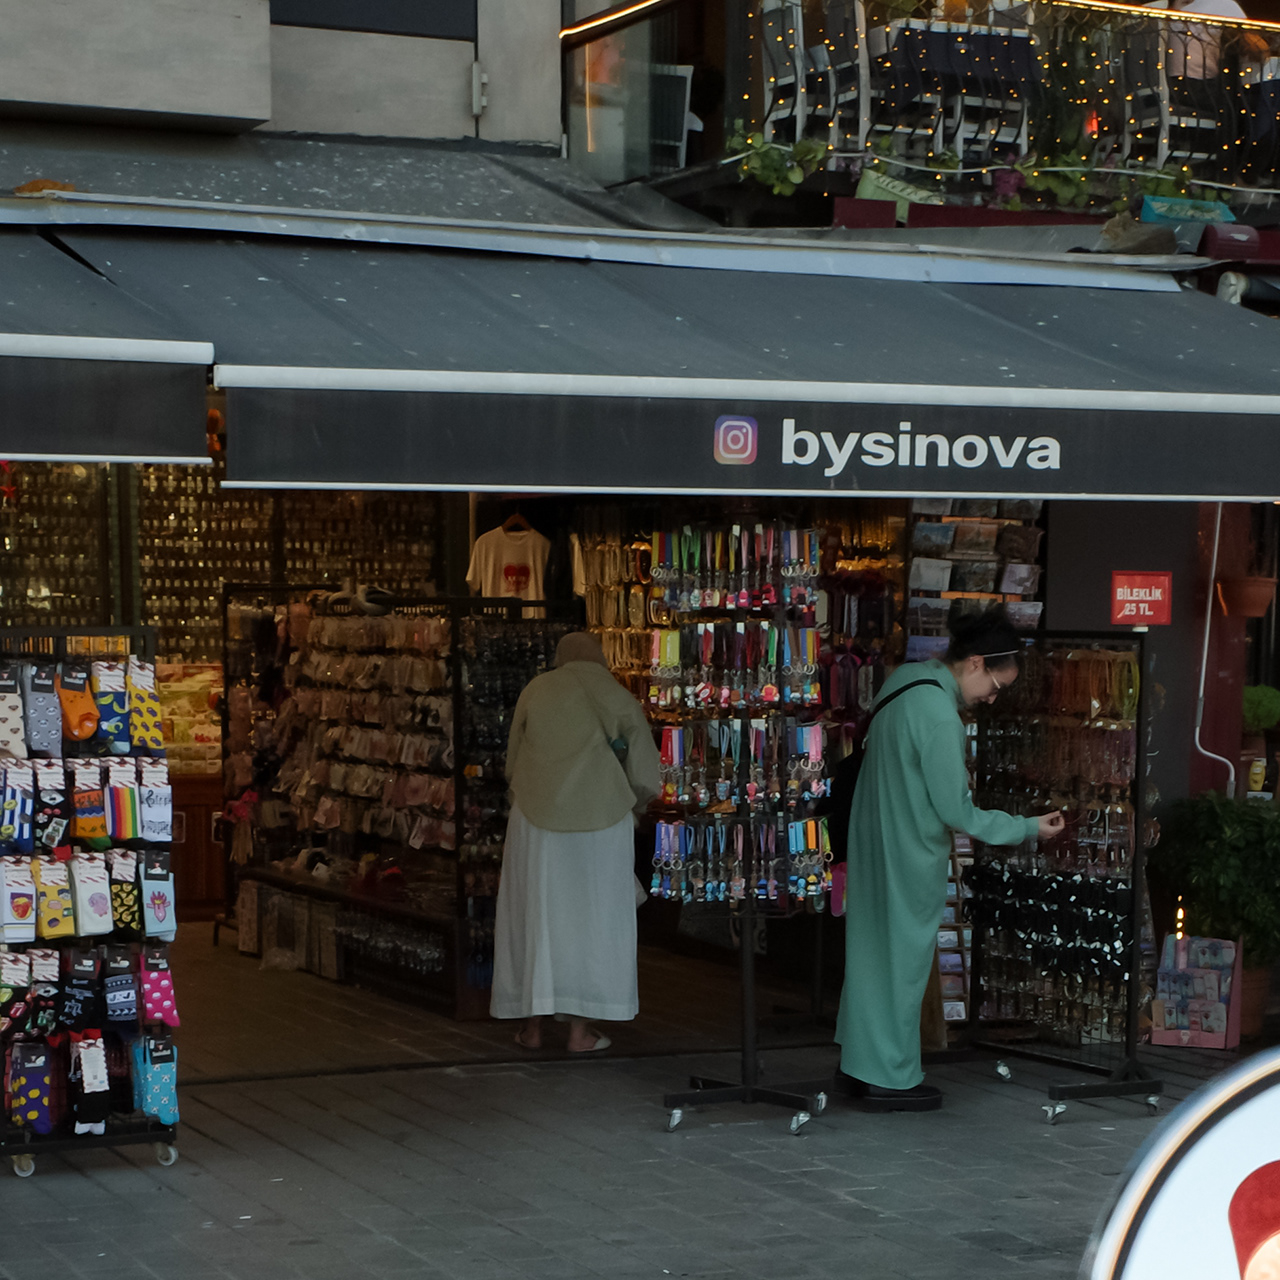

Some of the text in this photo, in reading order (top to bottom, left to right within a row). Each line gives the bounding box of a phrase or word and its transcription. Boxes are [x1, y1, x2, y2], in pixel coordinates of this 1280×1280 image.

[781, 417, 1061, 477] bysinova
[1116, 585, 1162, 601] BİLEKLİK
[1124, 602, 1137, 616] 25
